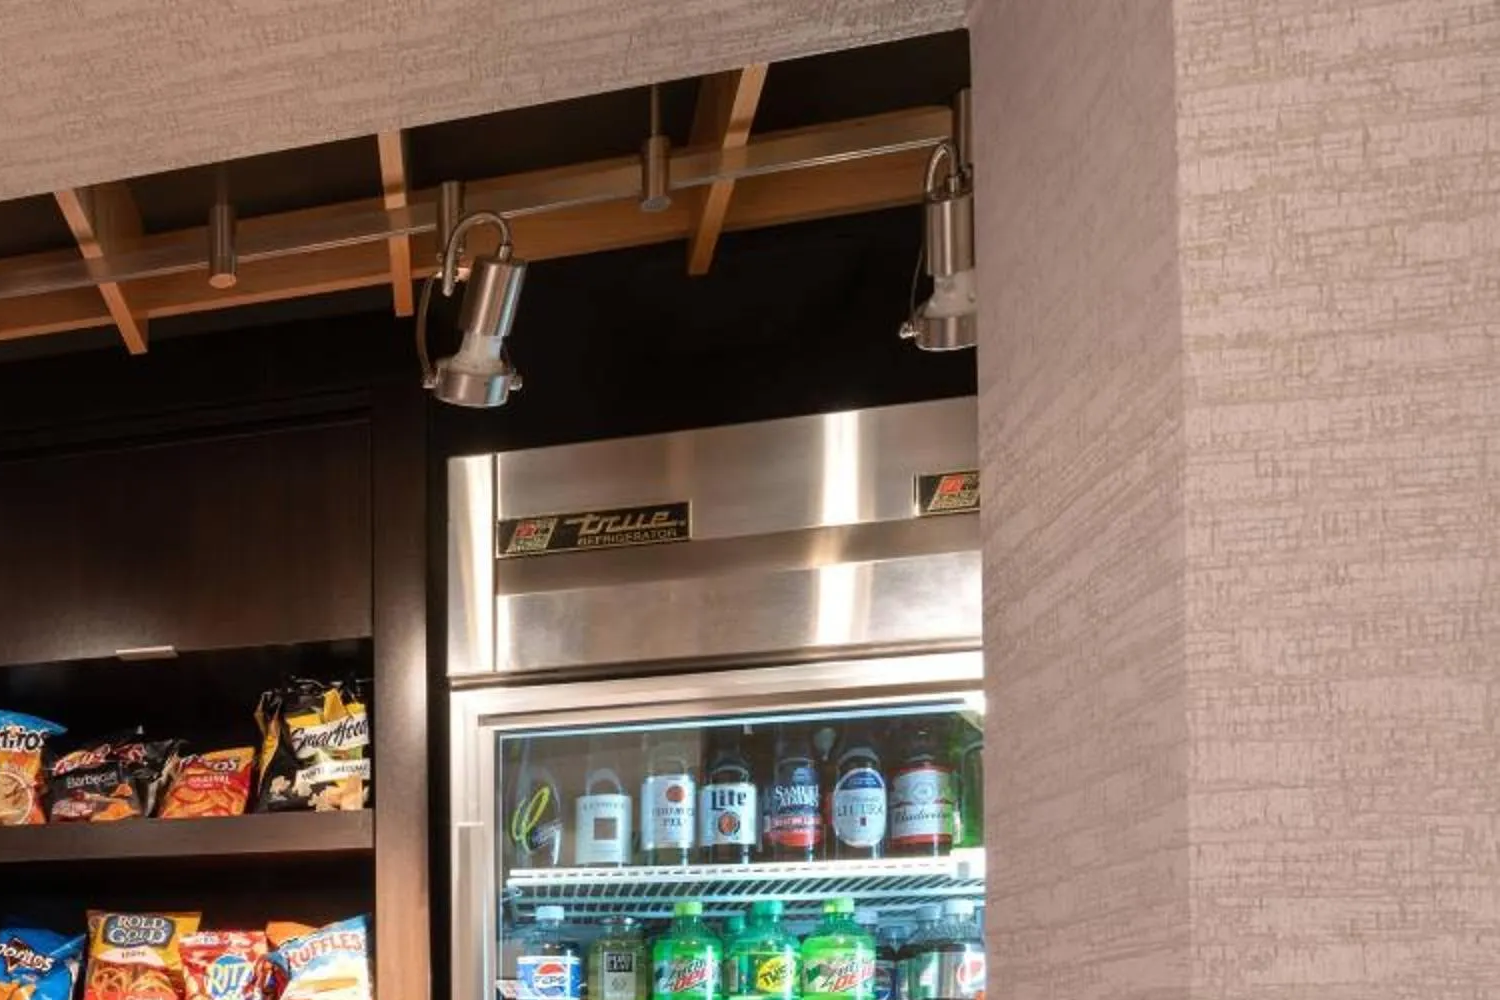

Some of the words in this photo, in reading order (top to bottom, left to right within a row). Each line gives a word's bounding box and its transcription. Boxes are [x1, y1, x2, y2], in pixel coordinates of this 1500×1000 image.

[577, 528, 677, 546] REFRIGERATOR
[710, 789, 748, 811] Lite
[117, 914, 166, 929] ROLD
[109, 927, 167, 944] GOLD
